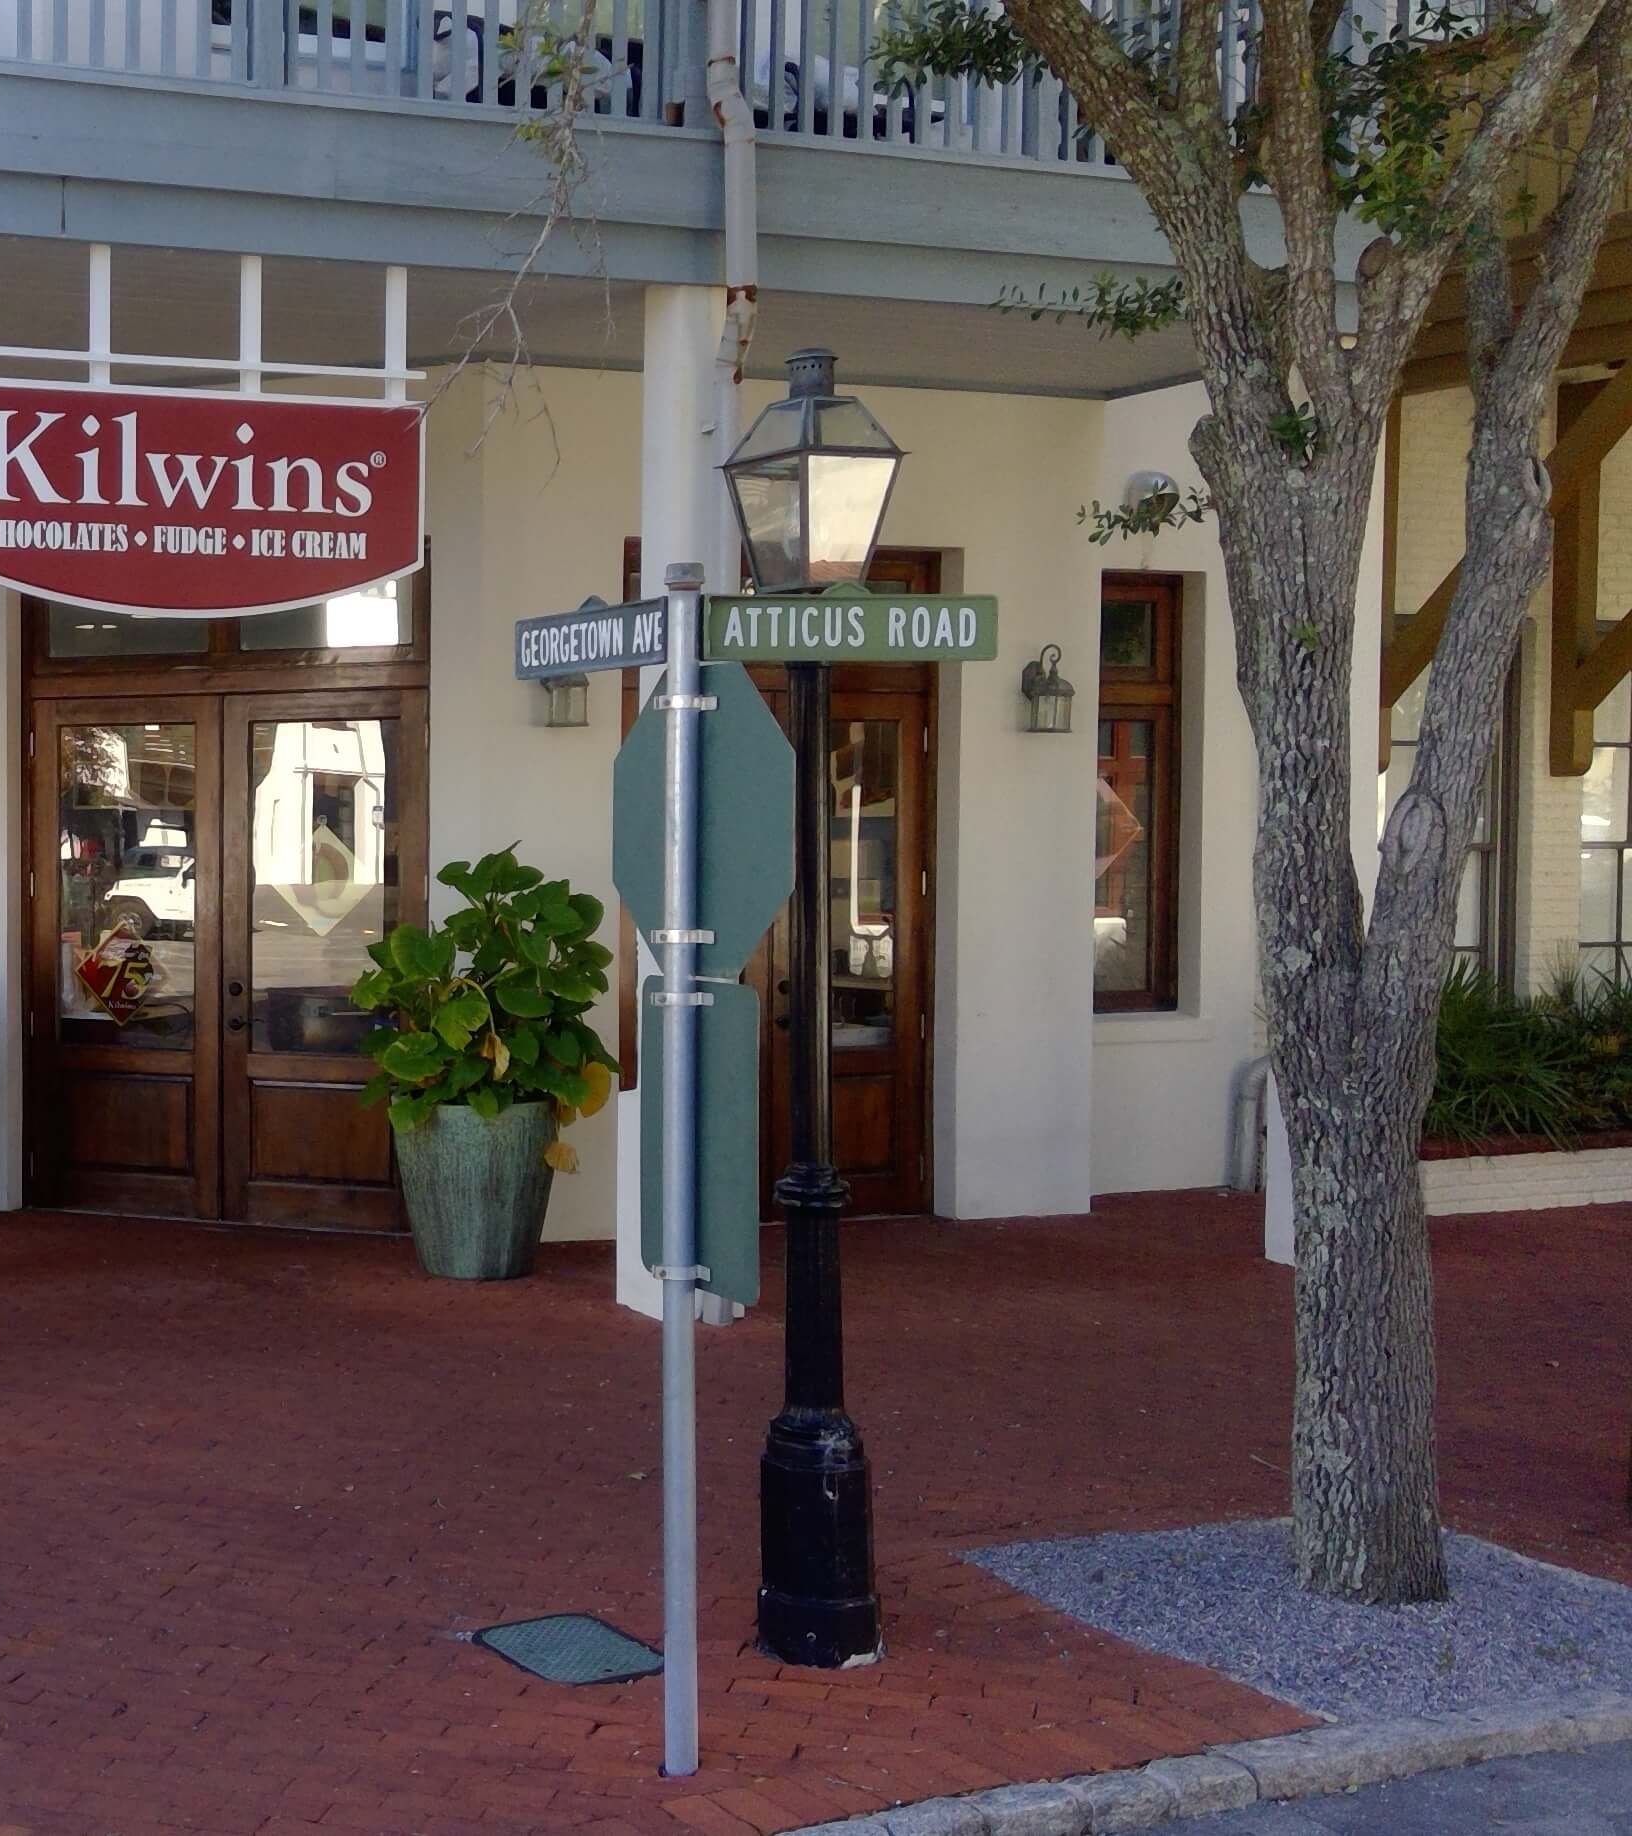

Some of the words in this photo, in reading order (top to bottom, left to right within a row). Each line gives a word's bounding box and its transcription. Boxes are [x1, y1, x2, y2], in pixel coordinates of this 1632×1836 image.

[153, 524, 228, 556] FUDGE
[250, 529, 286, 559] ICE
[291, 530, 368, 560] CREAM
[521, 616, 625, 668] GEORGETOWN
[632, 611, 664, 655] AVE
[723, 606, 866, 648] ATTICUS
[888, 606, 978, 648] ROAD
[97, 959, 145, 1000] 75
